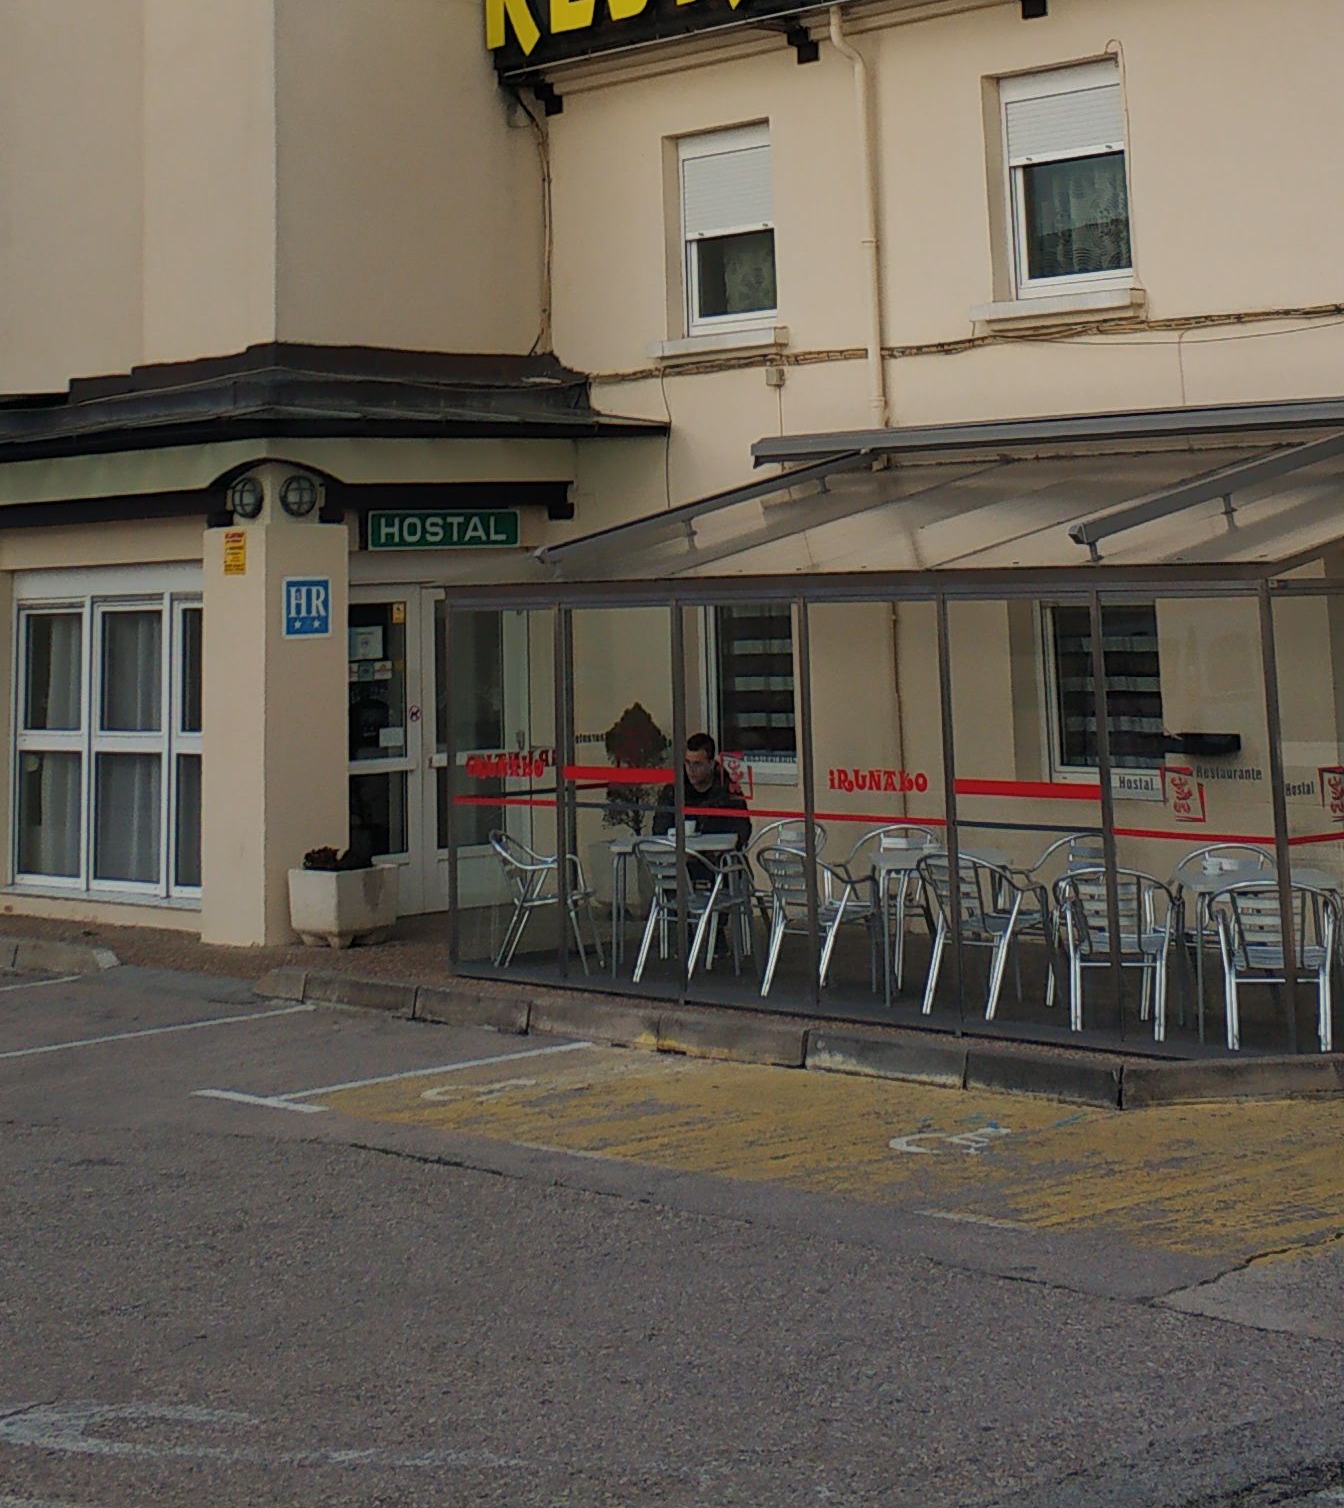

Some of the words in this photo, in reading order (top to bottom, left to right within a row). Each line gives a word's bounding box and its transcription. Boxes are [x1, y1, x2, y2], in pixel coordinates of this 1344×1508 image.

[380, 515, 507, 543] HOSTAL
[1118, 776, 1154, 791] Hostal
[1196, 766, 1262, 781] Restaurante
[1284, 780, 1315, 797] Hostal
